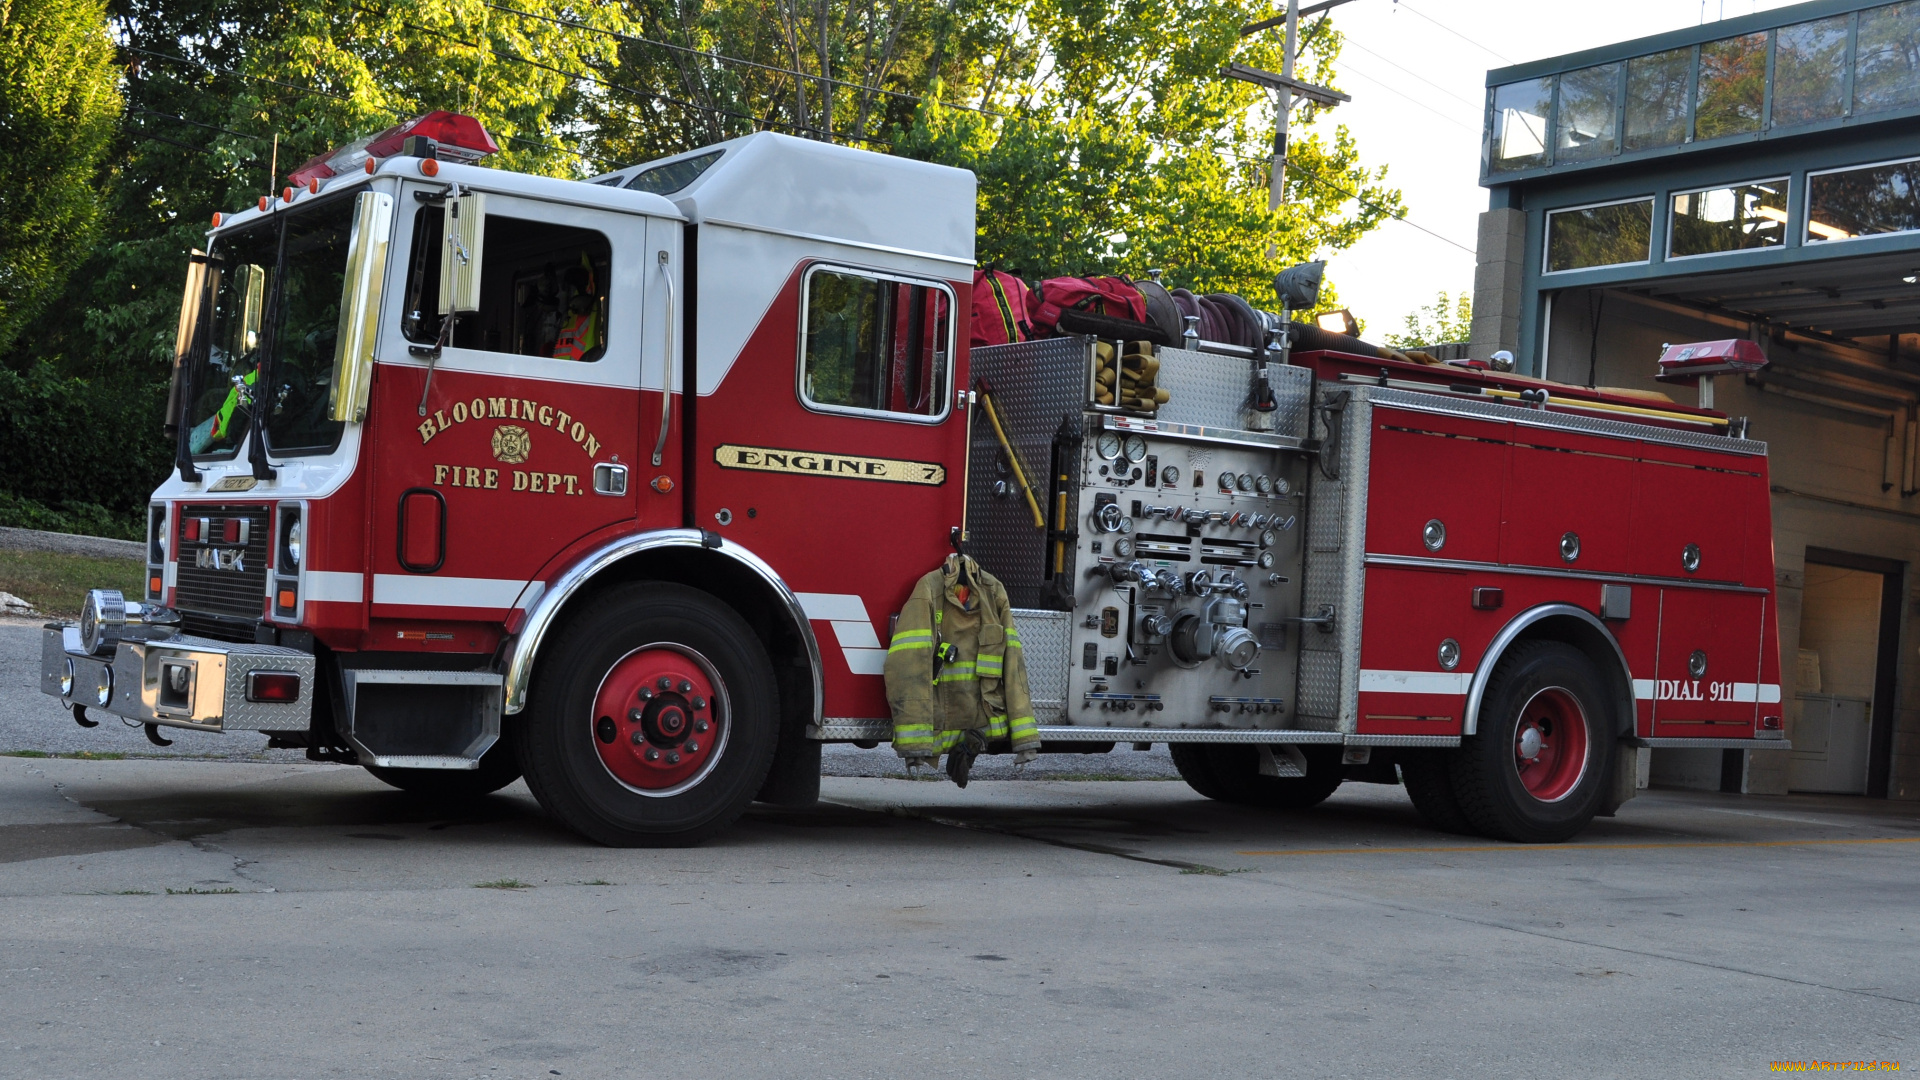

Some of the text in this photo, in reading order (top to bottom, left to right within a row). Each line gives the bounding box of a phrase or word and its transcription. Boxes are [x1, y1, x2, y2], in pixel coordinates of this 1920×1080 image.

[417, 397, 602, 459] BLOOMINGTON
[433, 464, 584, 496] FIRE DEPT.
[737, 450, 937, 480] ENGINE 7
[195, 548, 245, 571] MACK
[1658, 680, 1733, 702] DIAL 911
